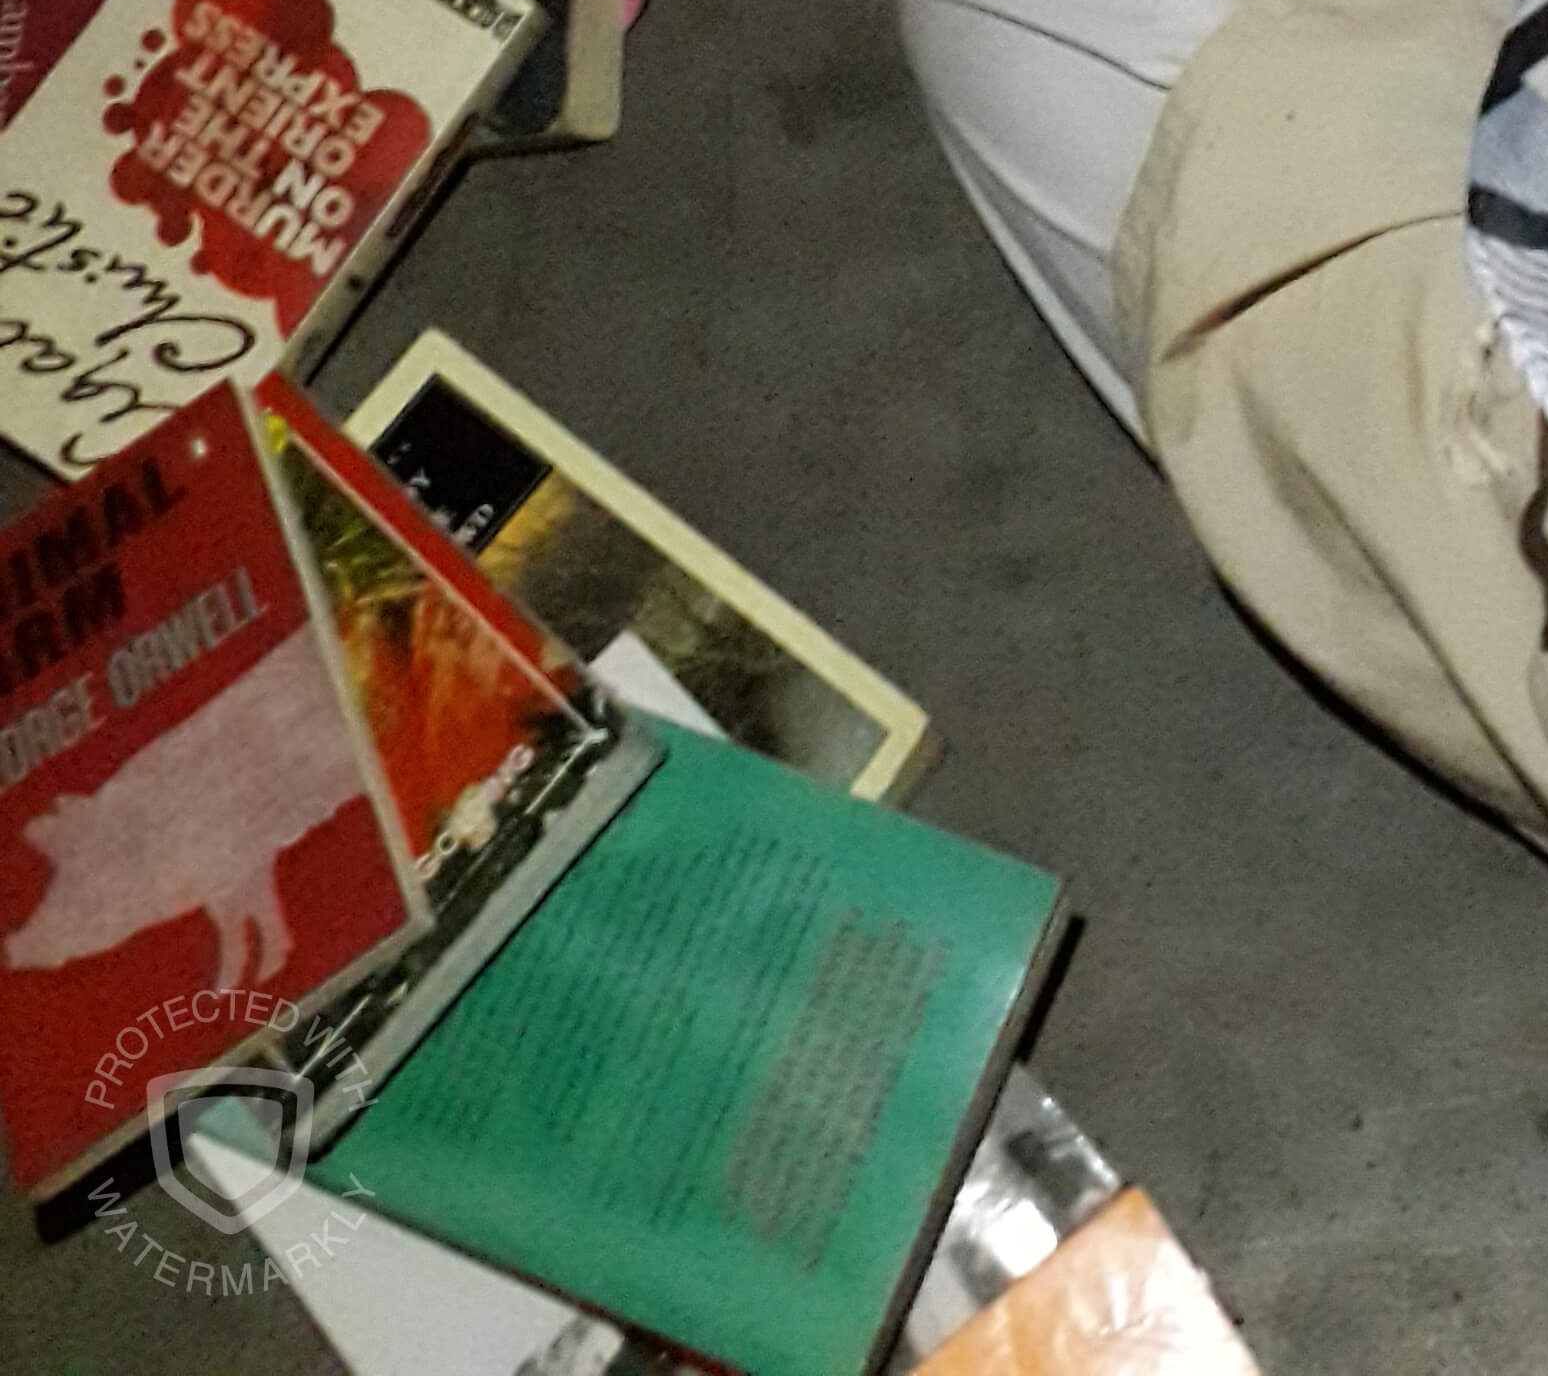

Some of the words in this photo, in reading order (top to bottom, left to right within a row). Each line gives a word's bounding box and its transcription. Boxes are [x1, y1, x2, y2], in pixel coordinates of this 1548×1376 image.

[169, 95, 272, 179] THE
[173, 51, 357, 177] ORIENT
[182, 0, 386, 147] EXPRESS
[136, 119, 347, 277] MURDER
[271, 155, 356, 230] ON
[107, 565, 271, 710] ORWELL
